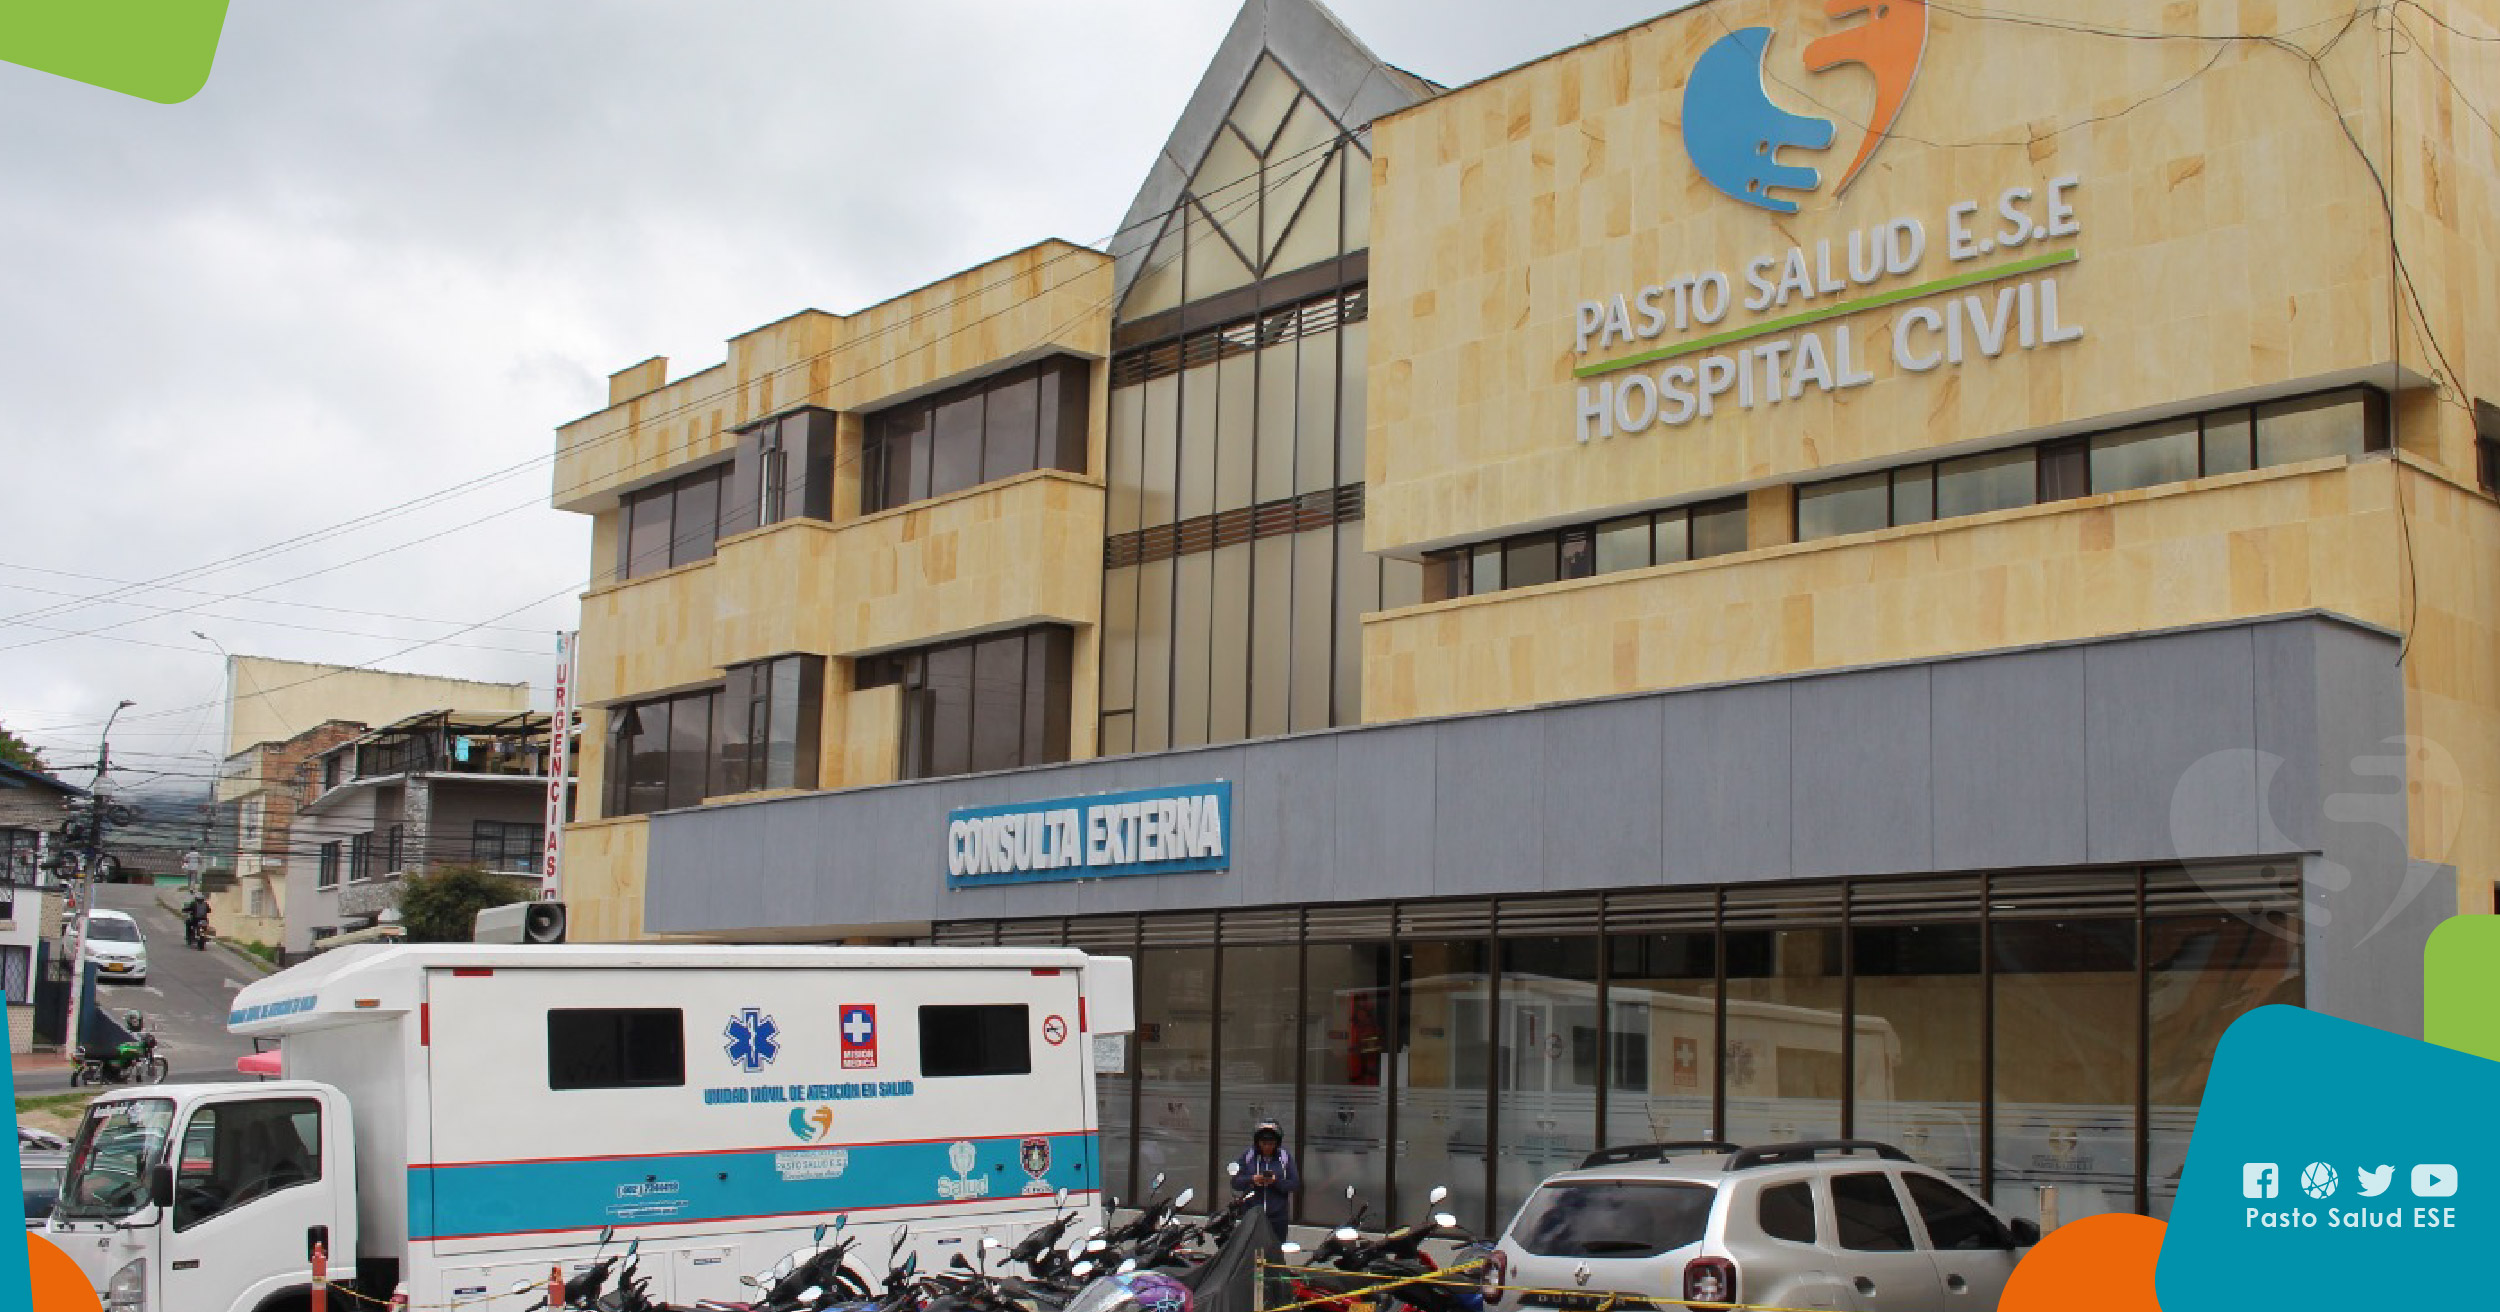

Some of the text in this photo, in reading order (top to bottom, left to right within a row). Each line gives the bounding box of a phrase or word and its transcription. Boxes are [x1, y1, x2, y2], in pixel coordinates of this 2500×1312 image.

[1575, 175, 2081, 354] PASTO SALUD E.S.E
[1576, 278, 2084, 444] HOSPITAL CIVIL
[546, 663, 568, 878] URGENCIAS
[949, 794, 1224, 876] CONSULTA EXTERNA
[704, 1087, 749, 1104] UNIDAD
[789, 1084, 806, 1102] DE
[862, 1082, 878, 1098] EN
[879, 1080, 915, 1097] SALUD
[938, 1172, 988, 1198] Salud
